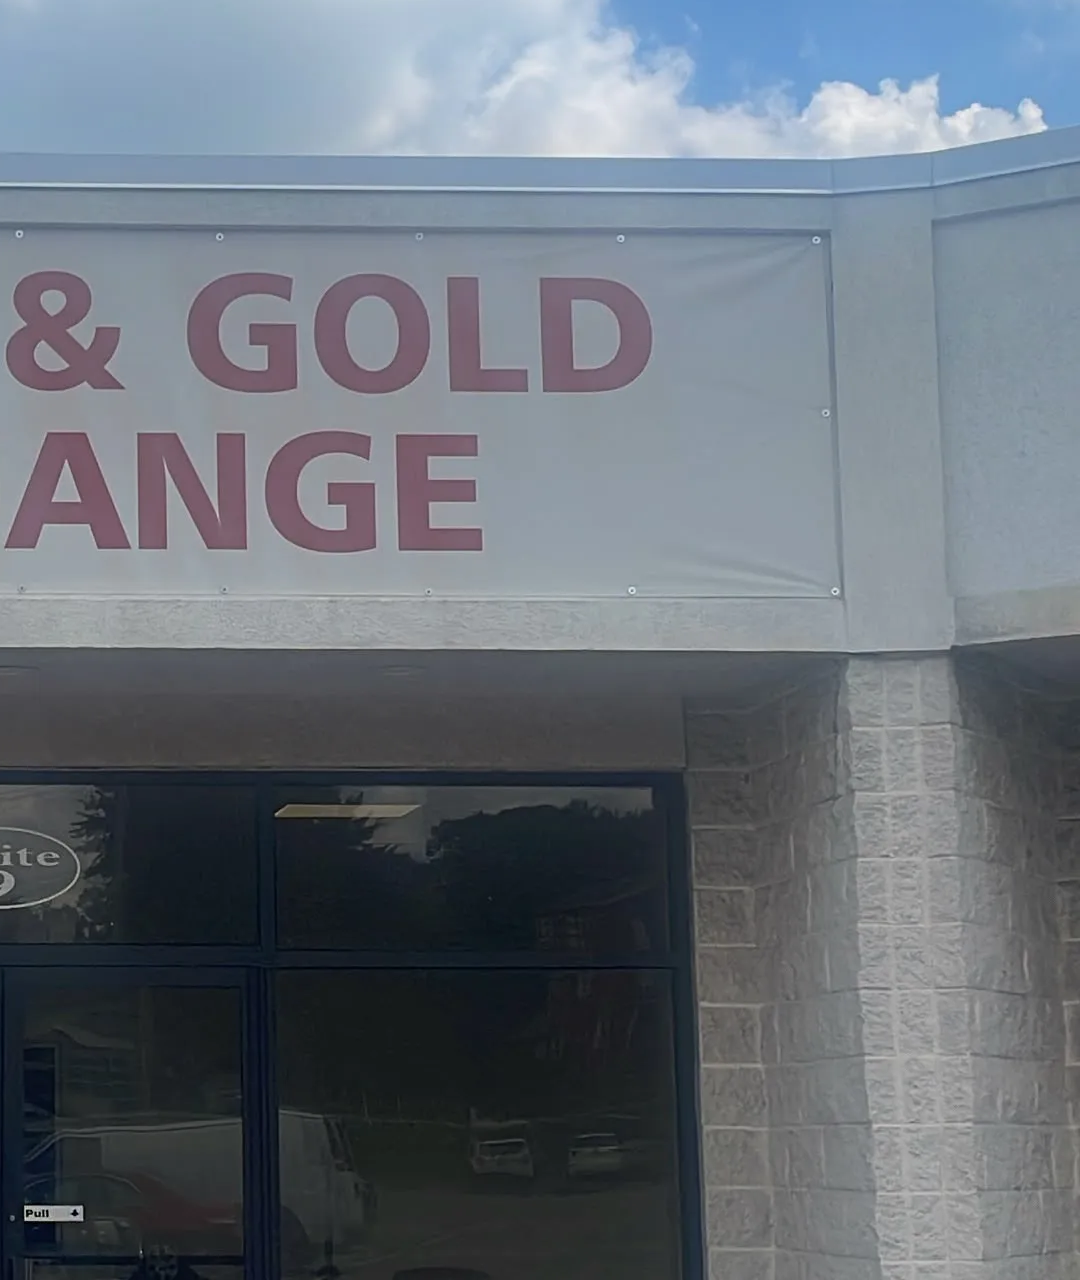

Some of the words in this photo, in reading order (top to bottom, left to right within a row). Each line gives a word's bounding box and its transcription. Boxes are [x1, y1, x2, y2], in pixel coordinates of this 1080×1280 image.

[5, 270, 126, 392] &
[186, 272, 653, 394] GOLD
[25, 1209, 49, 1218] Pull
